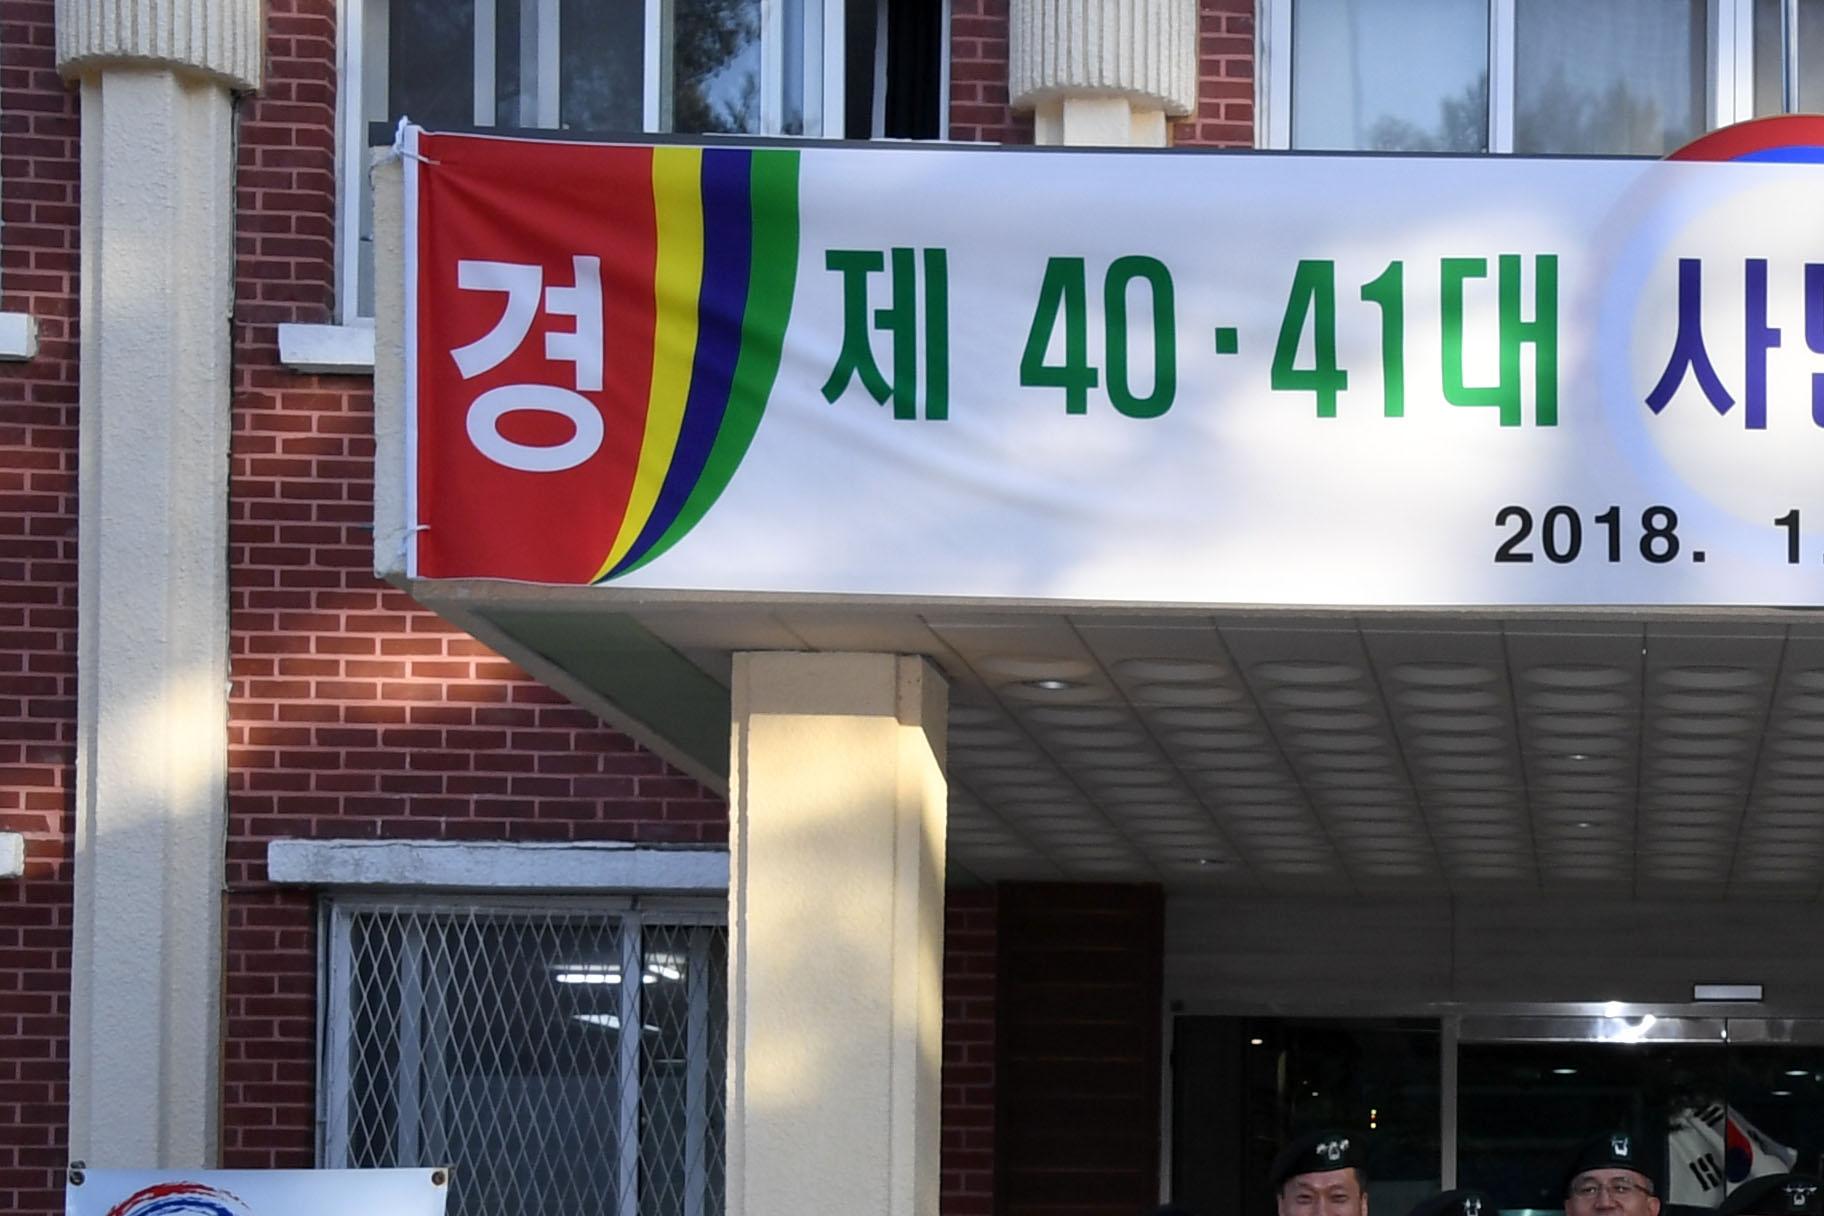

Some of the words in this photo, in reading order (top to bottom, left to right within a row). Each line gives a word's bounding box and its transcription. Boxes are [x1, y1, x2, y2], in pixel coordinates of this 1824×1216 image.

[450, 256, 605, 472] 경
[824, 250, 948, 420] 제
[1494, 505, 1705, 564] 2018.
